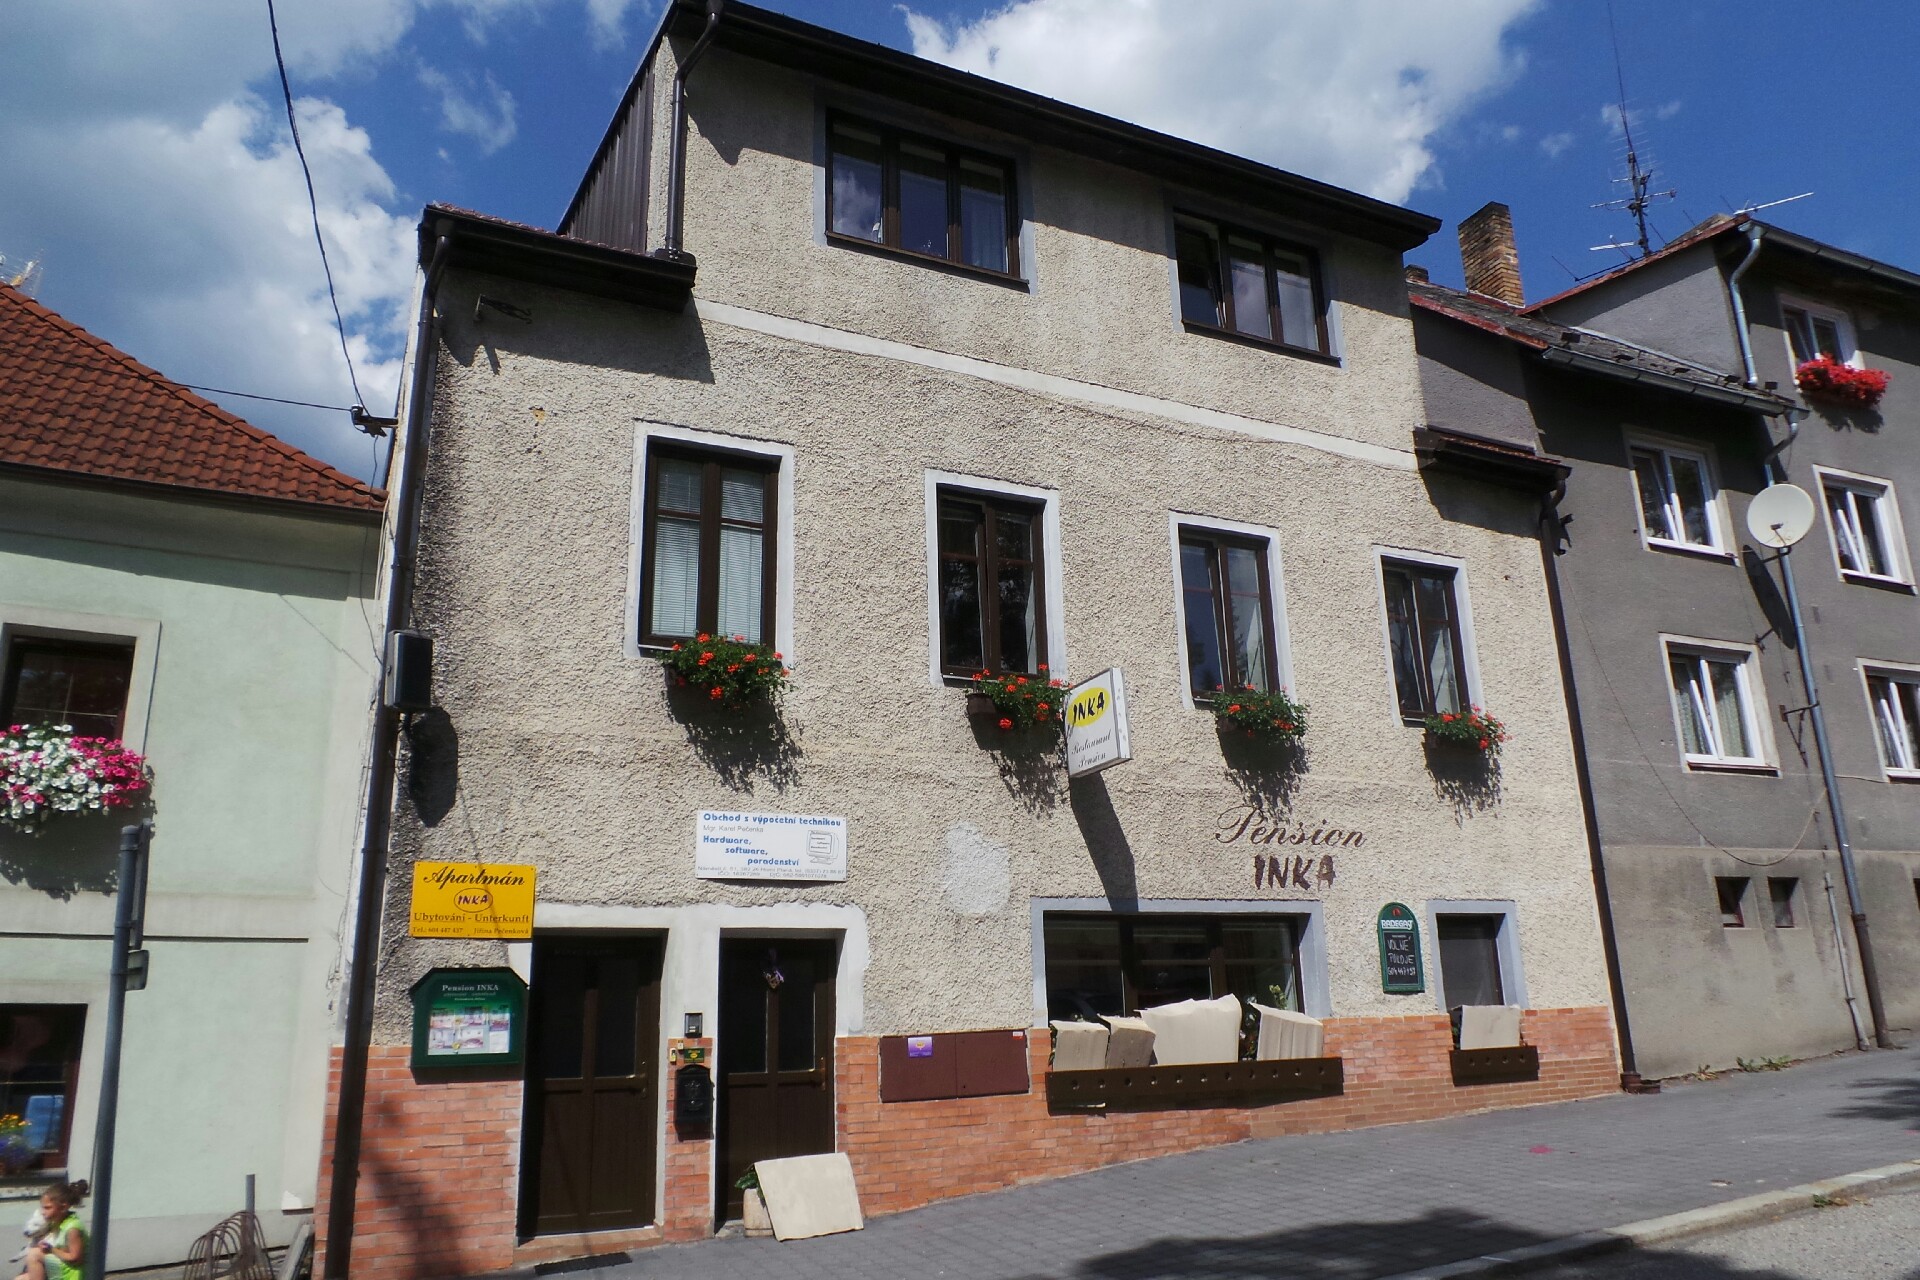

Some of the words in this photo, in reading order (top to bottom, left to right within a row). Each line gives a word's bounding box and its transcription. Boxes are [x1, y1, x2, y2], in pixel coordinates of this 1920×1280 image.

[1072, 692, 1106, 723] INKA
[1071, 729, 1112, 755] Restaurant
[703, 812, 741, 822] Obchod
[752, 814, 797, 825] výpočetní
[799, 817, 842, 827] technikou
[1214, 805, 1367, 848] Pension
[703, 835, 752, 845] Hardware,
[725, 847, 768, 855] software,
[747, 857, 800, 866] poradenství
[423, 866, 525, 890] Apartmán
[1254, 854, 1337, 891] INKA
[458, 894, 490, 905] INKA
[414, 912, 466, 923] Ubytování
[474, 913, 529, 923] Unterkunft
[442, 984, 475, 992] Pension
